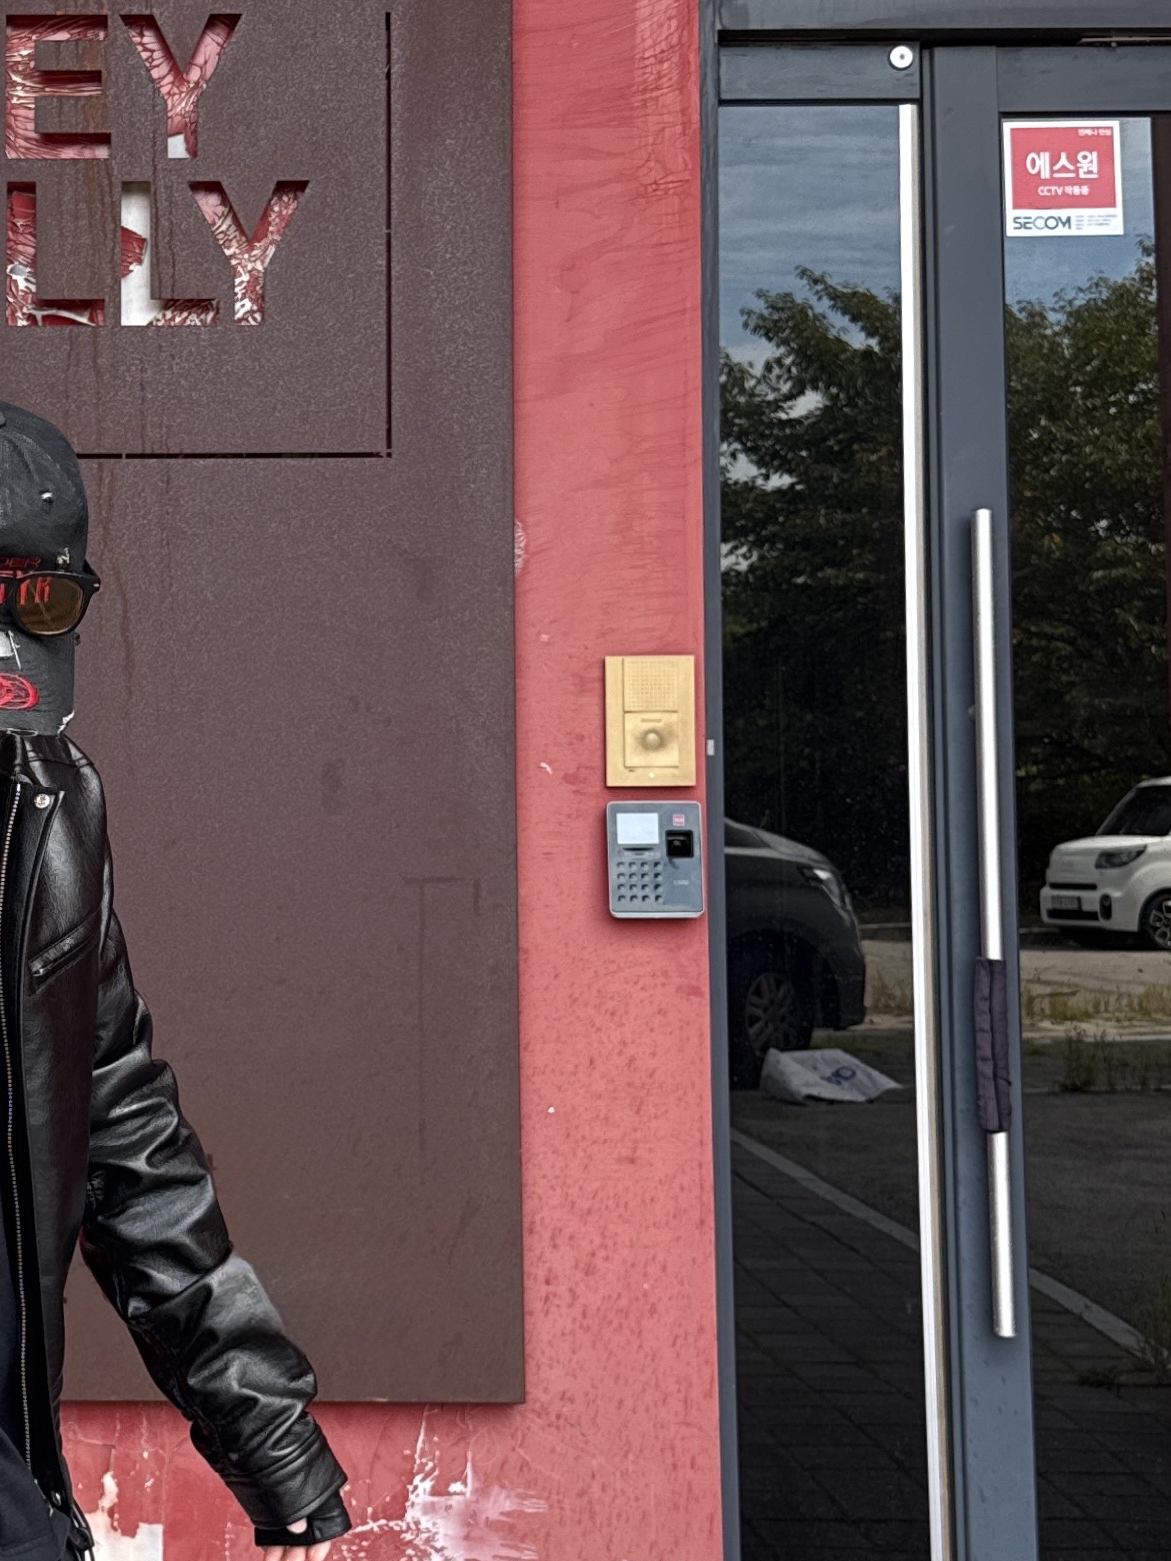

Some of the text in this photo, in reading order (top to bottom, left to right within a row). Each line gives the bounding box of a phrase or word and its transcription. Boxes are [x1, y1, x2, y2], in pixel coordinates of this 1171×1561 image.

[1025, 150, 1099, 179] 에스원
[1037, 185, 1063, 196] CCTV
[1013, 216, 1072, 230] SECOM
